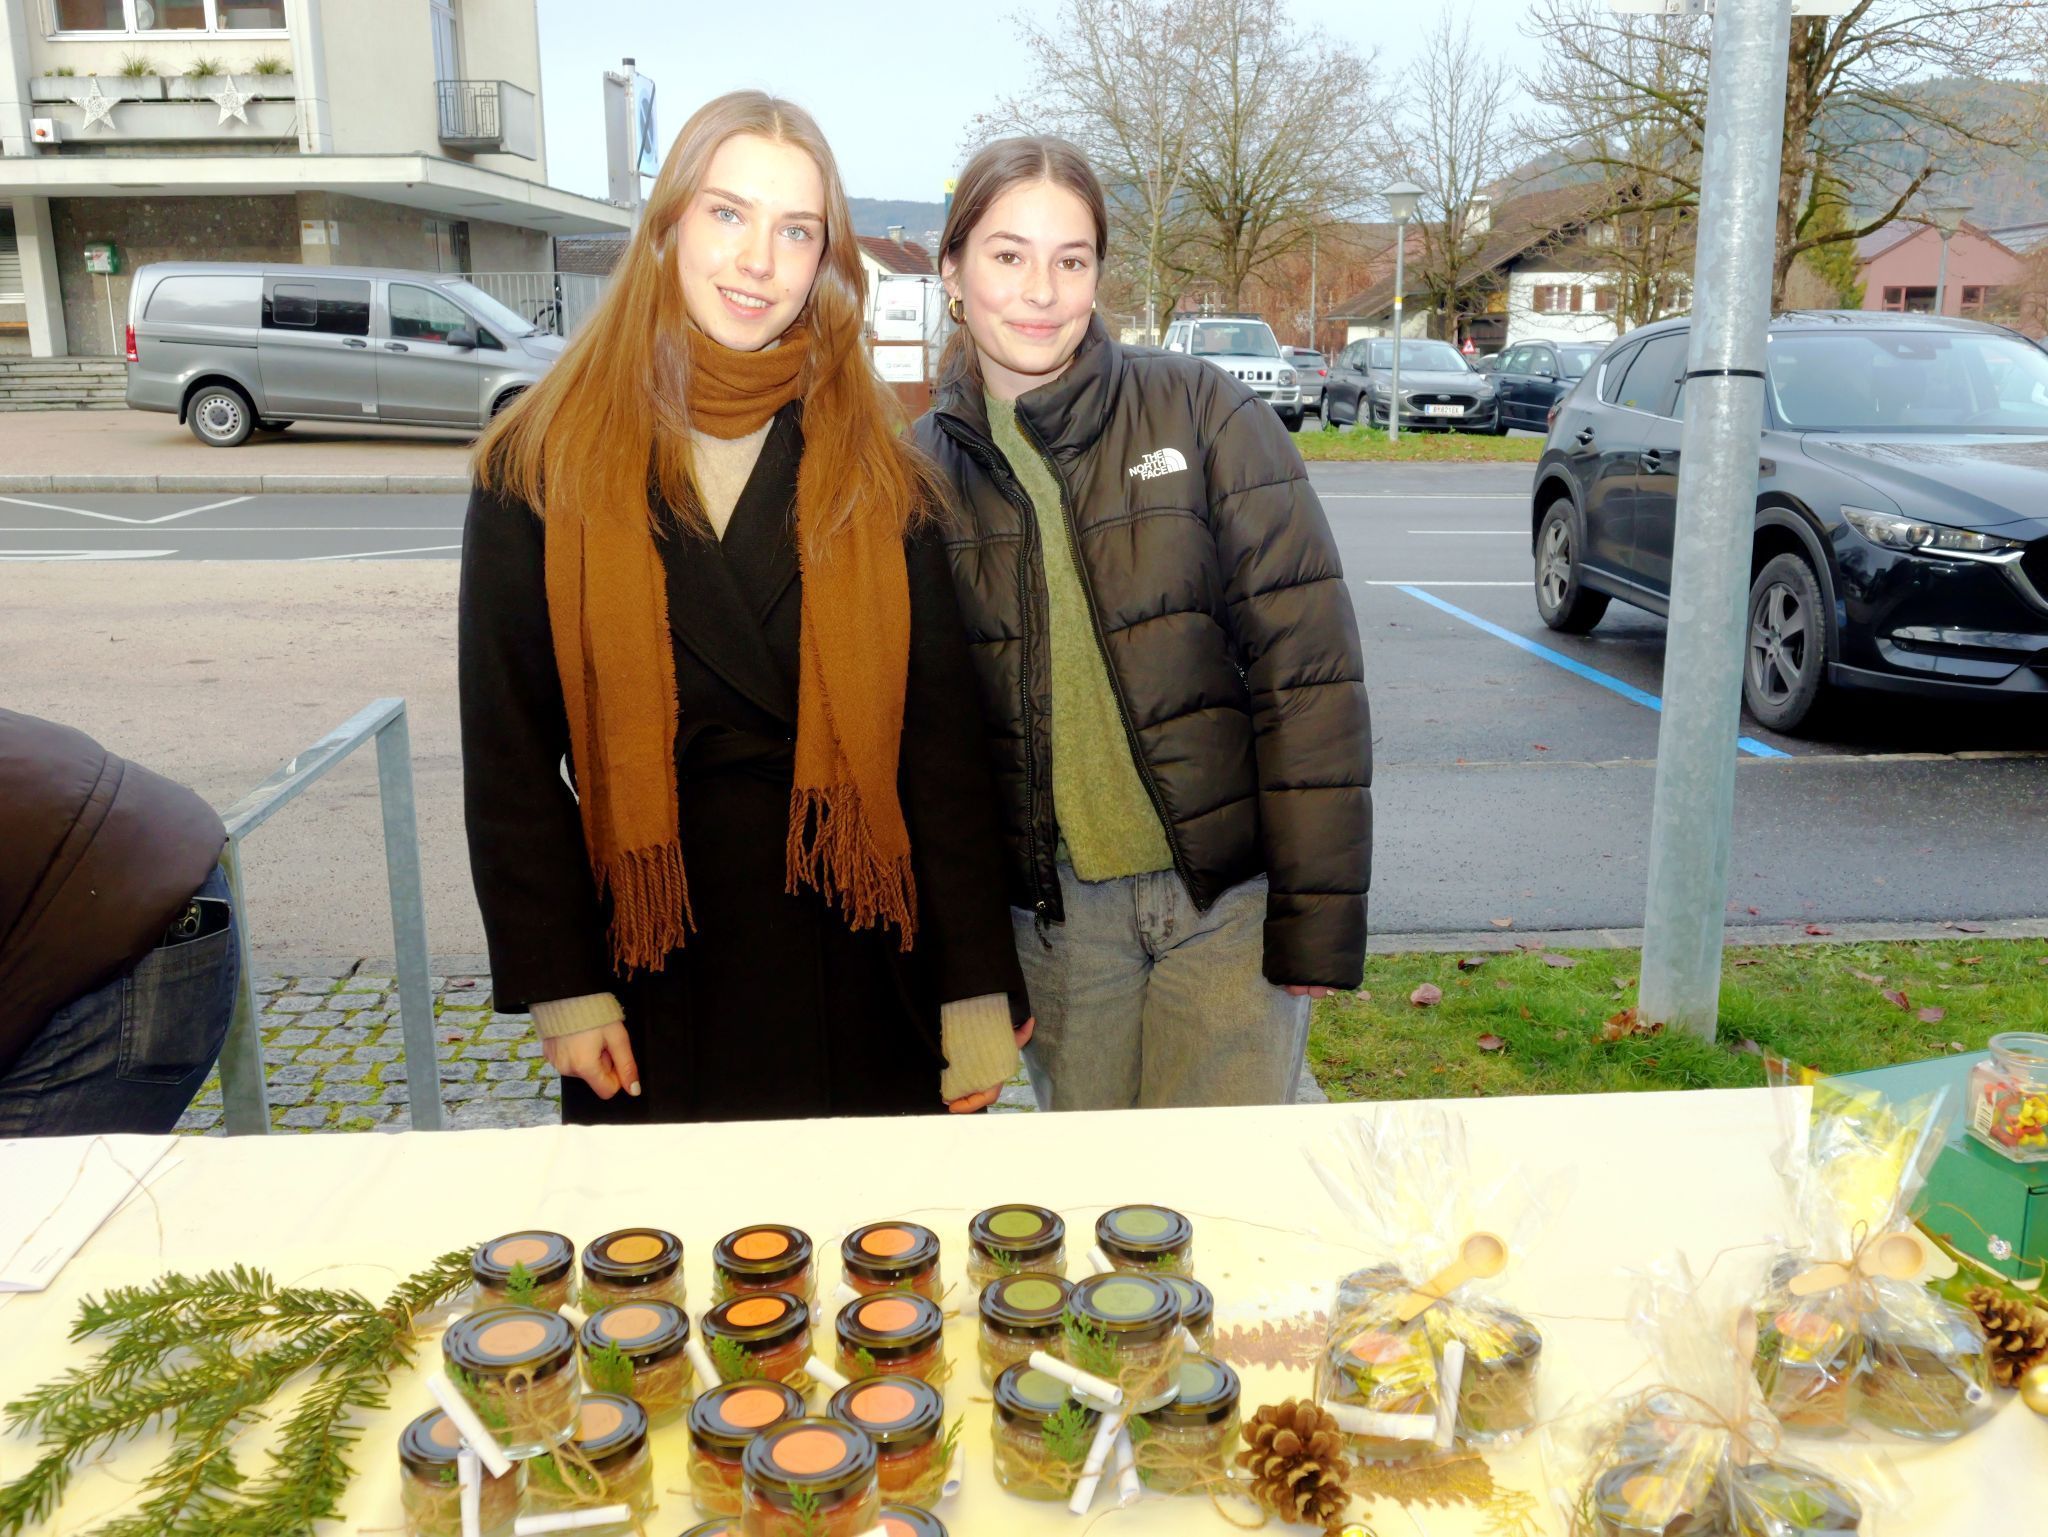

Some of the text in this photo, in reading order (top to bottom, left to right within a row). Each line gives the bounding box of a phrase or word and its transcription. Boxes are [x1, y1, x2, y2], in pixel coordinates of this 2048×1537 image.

[1142, 450, 1163, 463] THE
[1129, 457, 1167, 477] NORTH
[1141, 465, 1169, 480] FACE
